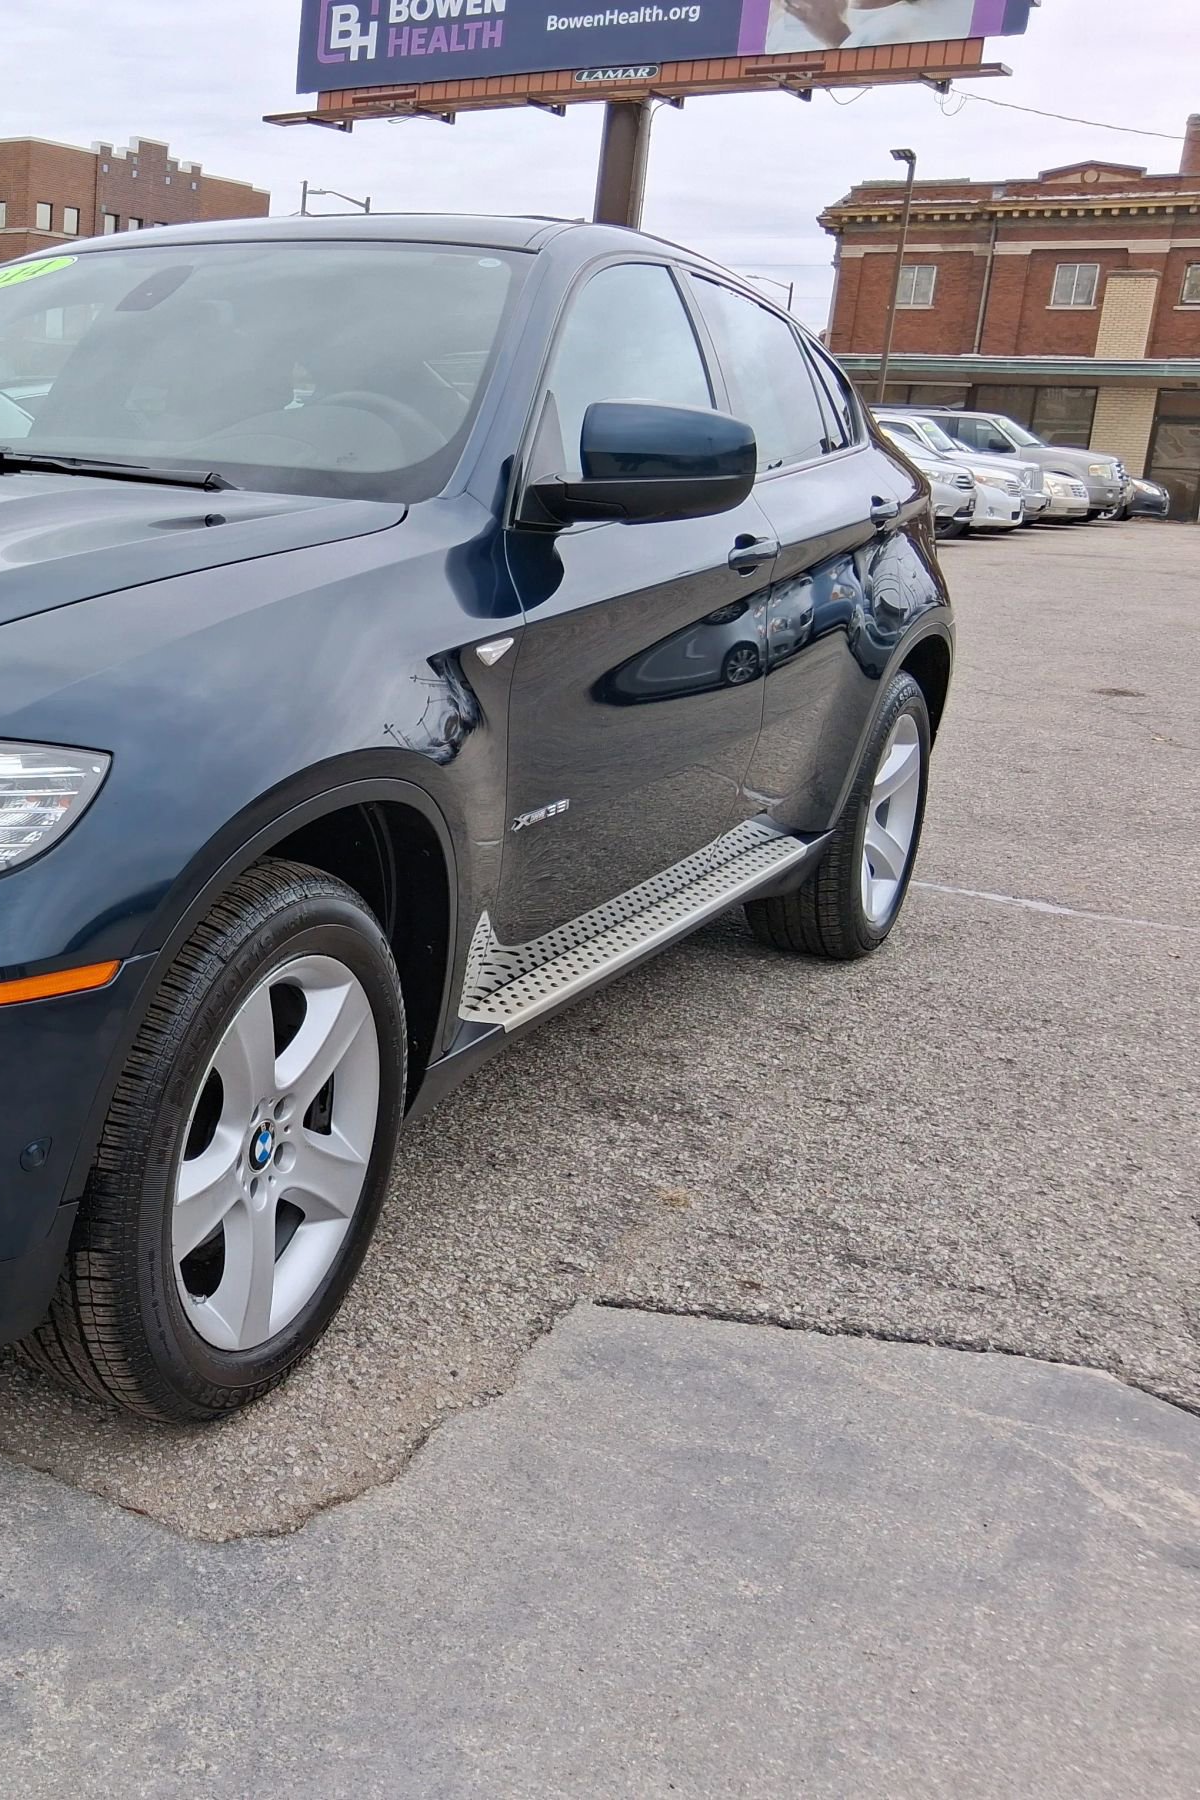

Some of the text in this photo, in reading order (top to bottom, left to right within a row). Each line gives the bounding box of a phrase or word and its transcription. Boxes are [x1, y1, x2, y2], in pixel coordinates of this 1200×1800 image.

[546, 5, 701, 31] BowenHealth.org
[387, 20, 504, 58] HEALTH
[581, 67, 650, 81] LAMAR
